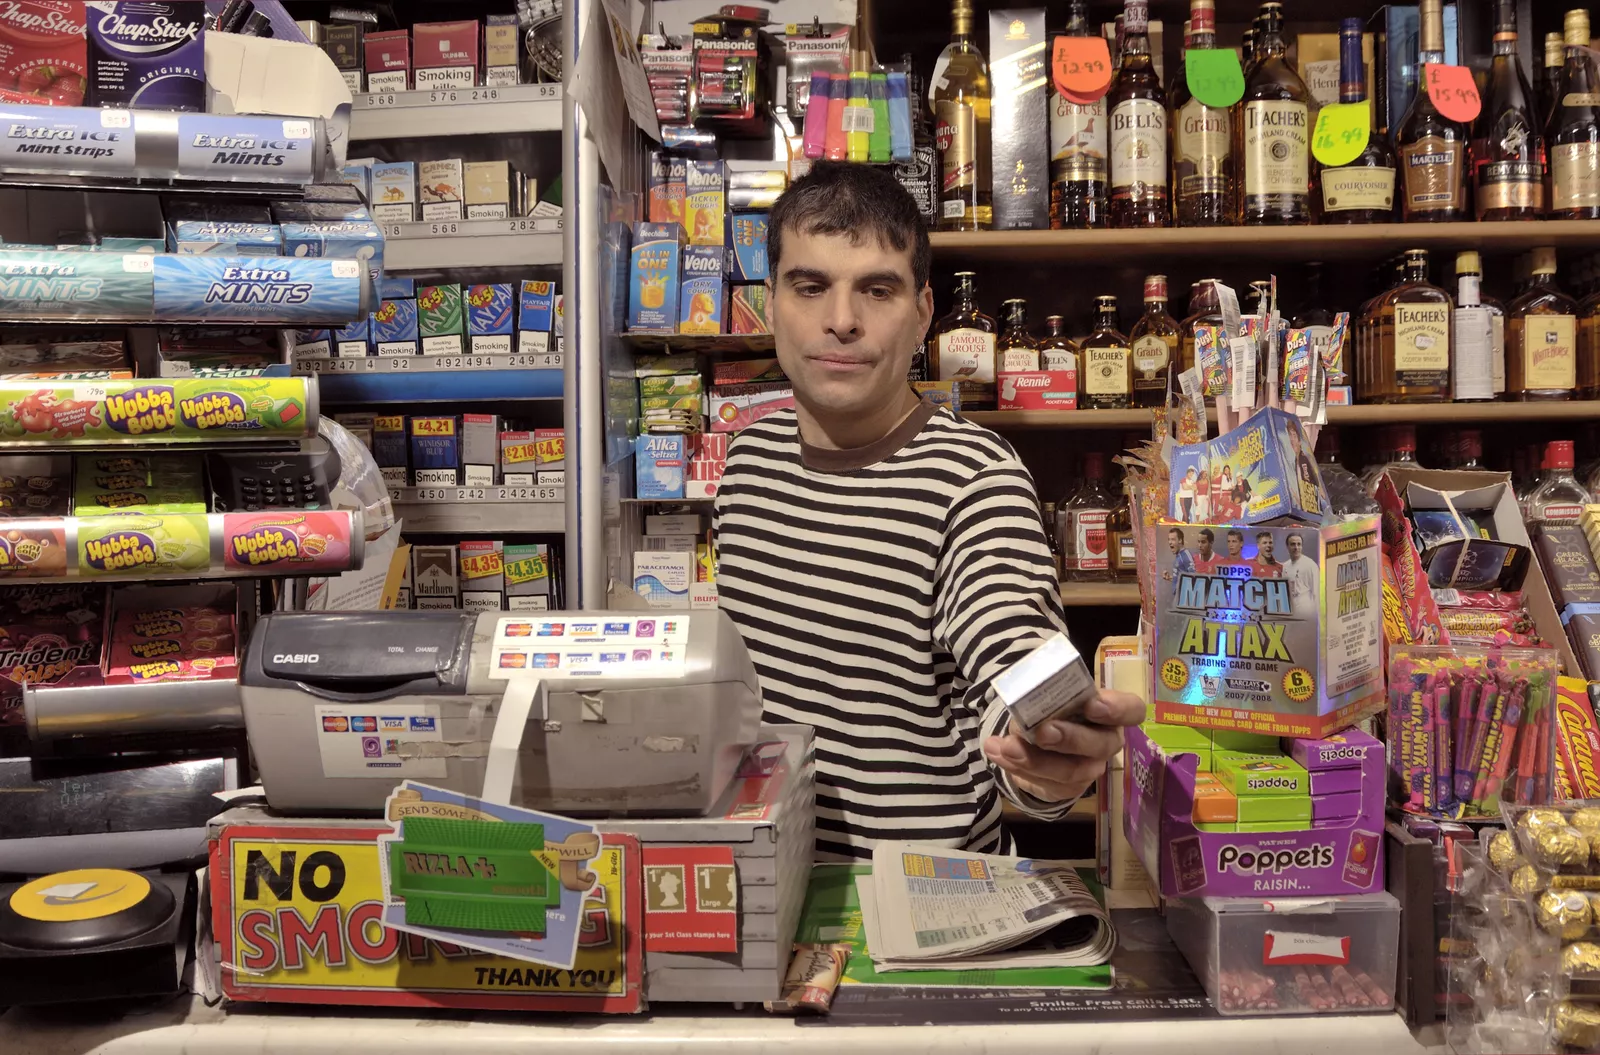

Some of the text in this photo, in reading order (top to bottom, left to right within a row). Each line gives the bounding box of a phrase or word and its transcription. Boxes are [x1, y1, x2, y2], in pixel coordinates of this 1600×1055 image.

[97, 13, 200, 41] ChapStick
[693, 39, 756, 50] Panasonic
[788, 40, 849, 51] Panasonic
[9, 58, 84, 76] STRAWBERRY
[1062, 60, 1105, 75] 12.99
[139, 67, 198, 83] ORIGINAL
[370, 75, 404, 85] Smoking
[418, 70, 472, 82] Smoking
[489, 69, 515, 81] Smoking
[1430, 69, 1441, 84] £
[1056, 104, 1103, 117] GROUSE
[1247, 106, 1306, 129] TEACHER'S
[1113, 111, 1163, 131] BELL'S
[1184, 115, 1228, 134] Grant's
[7, 124, 121, 142] Extra ICE
[1286, 130, 1307, 146] CREAM
[192, 133, 299, 151] Extra ICE
[16, 144, 116, 158] Mint Strips
[212, 152, 286, 166] Mints
[1411, 151, 1453, 167] MARTELL
[374, 168, 411, 179] CAMEL
[422, 163, 457, 174] CAMEL
[652, 162, 687, 178] Veno's
[687, 172, 723, 186] Veno's
[653, 186, 685, 194] CHESTY
[1334, 181, 1389, 192] COURVOISIER
[690, 195, 719, 203] TICKLY
[469, 210, 505, 220] Smoking
[640, 229, 670, 238] Beechams
[743, 219, 754, 247] ONE
[640, 250, 658, 258] ALL
[637, 258, 669, 270] ONE
[685, 254, 722, 271] Veno's
[5, 263, 76, 277] Extra
[221, 267, 290, 283] Extra
[205, 283, 314, 305] MINTS
[687, 287, 717, 295] COUGHS
[522, 299, 551, 307] MAYFAIR
[1397, 307, 1446, 325] TEACHER'S
[1398, 325, 1446, 338] HIGHLAND CREAM
[474, 342, 509, 351] Smoking
[949, 335, 986, 344] FAMOUS
[296, 346, 327, 357] Smoking
[380, 346, 415, 355] Smoking
[947, 344, 987, 353] GROUSE
[1089, 349, 1124, 362] TEACHER'S
[1136, 346, 1163, 358] Grant's
[1043, 355, 1068, 366] BELL'S
[643, 379, 669, 387] LEMSIP
[1016, 375, 1052, 388] Rennie
[106, 389, 173, 423] Hubba
[181, 394, 231, 420] Hubba
[196, 404, 246, 430] Bubba
[375, 418, 401, 429] £2.12
[418, 420, 449, 432] £4.21
[418, 439, 450, 448] WINDSOR
[645, 438, 678, 451] Alka
[1238, 427, 1263, 449] HIGH
[425, 448, 444, 456] BLUE
[506, 444, 535, 459] £2.18
[416, 471, 456, 485] Smoking
[1258, 495, 1280, 507] PANINI
[1545, 507, 1582, 517] KOMMISSAR
[86, 535, 140, 562] Hubba
[233, 530, 285, 556] Hubba
[104, 546, 155, 571] Bubba
[249, 540, 298, 565] Bubba
[463, 554, 499, 573] £4.35
[506, 559, 543, 578] £4.35
[1216, 565, 1252, 577] TOPPS
[1336, 558, 1370, 588] MATCH
[418, 579, 453, 594] Marlboro
[1177, 574, 1293, 615] MATCH
[1337, 584, 1370, 618] ATTAX
[464, 598, 499, 607] Smoking
[1179, 618, 1295, 664] ATTAX
[0, 641, 94, 667] Trident
[272, 654, 320, 664] CASIO
[569, 656, 589, 664] VISA
[142, 665, 179, 679] Bubba
[1191, 657, 1279, 673] TRADING CARD GAME
[1229, 678, 1260, 687] BARCLAYS
[1291, 671, 1304, 687] 6
[1224, 692, 1272, 702] 2007/2008
[1288, 685, 1311, 695] PLAYERS
[1194, 706, 1277, 723] THE NEW AND ONLY OFFICIAL
[384, 720, 403, 728] VISA
[1163, 712, 1312, 735] PREMIER LEAGUE TRADING CARD GAME FROM TOPPS
[1247, 777, 1299, 791] Poppets
[397, 805, 466, 818] SEND SOME
[1258, 838, 1297, 847] PAYNES
[539, 853, 557, 871] NEW
[1217, 843, 1335, 875] Poppets
[244, 850, 347, 903] NO
[491, 884, 546, 896] smooth
[701, 899, 721, 907] Large
[649, 931, 731, 940] your 1st Class stamps here
[475, 966, 616, 988] THANK YOU
[1029, 1000, 1082, 1008] Smile.
